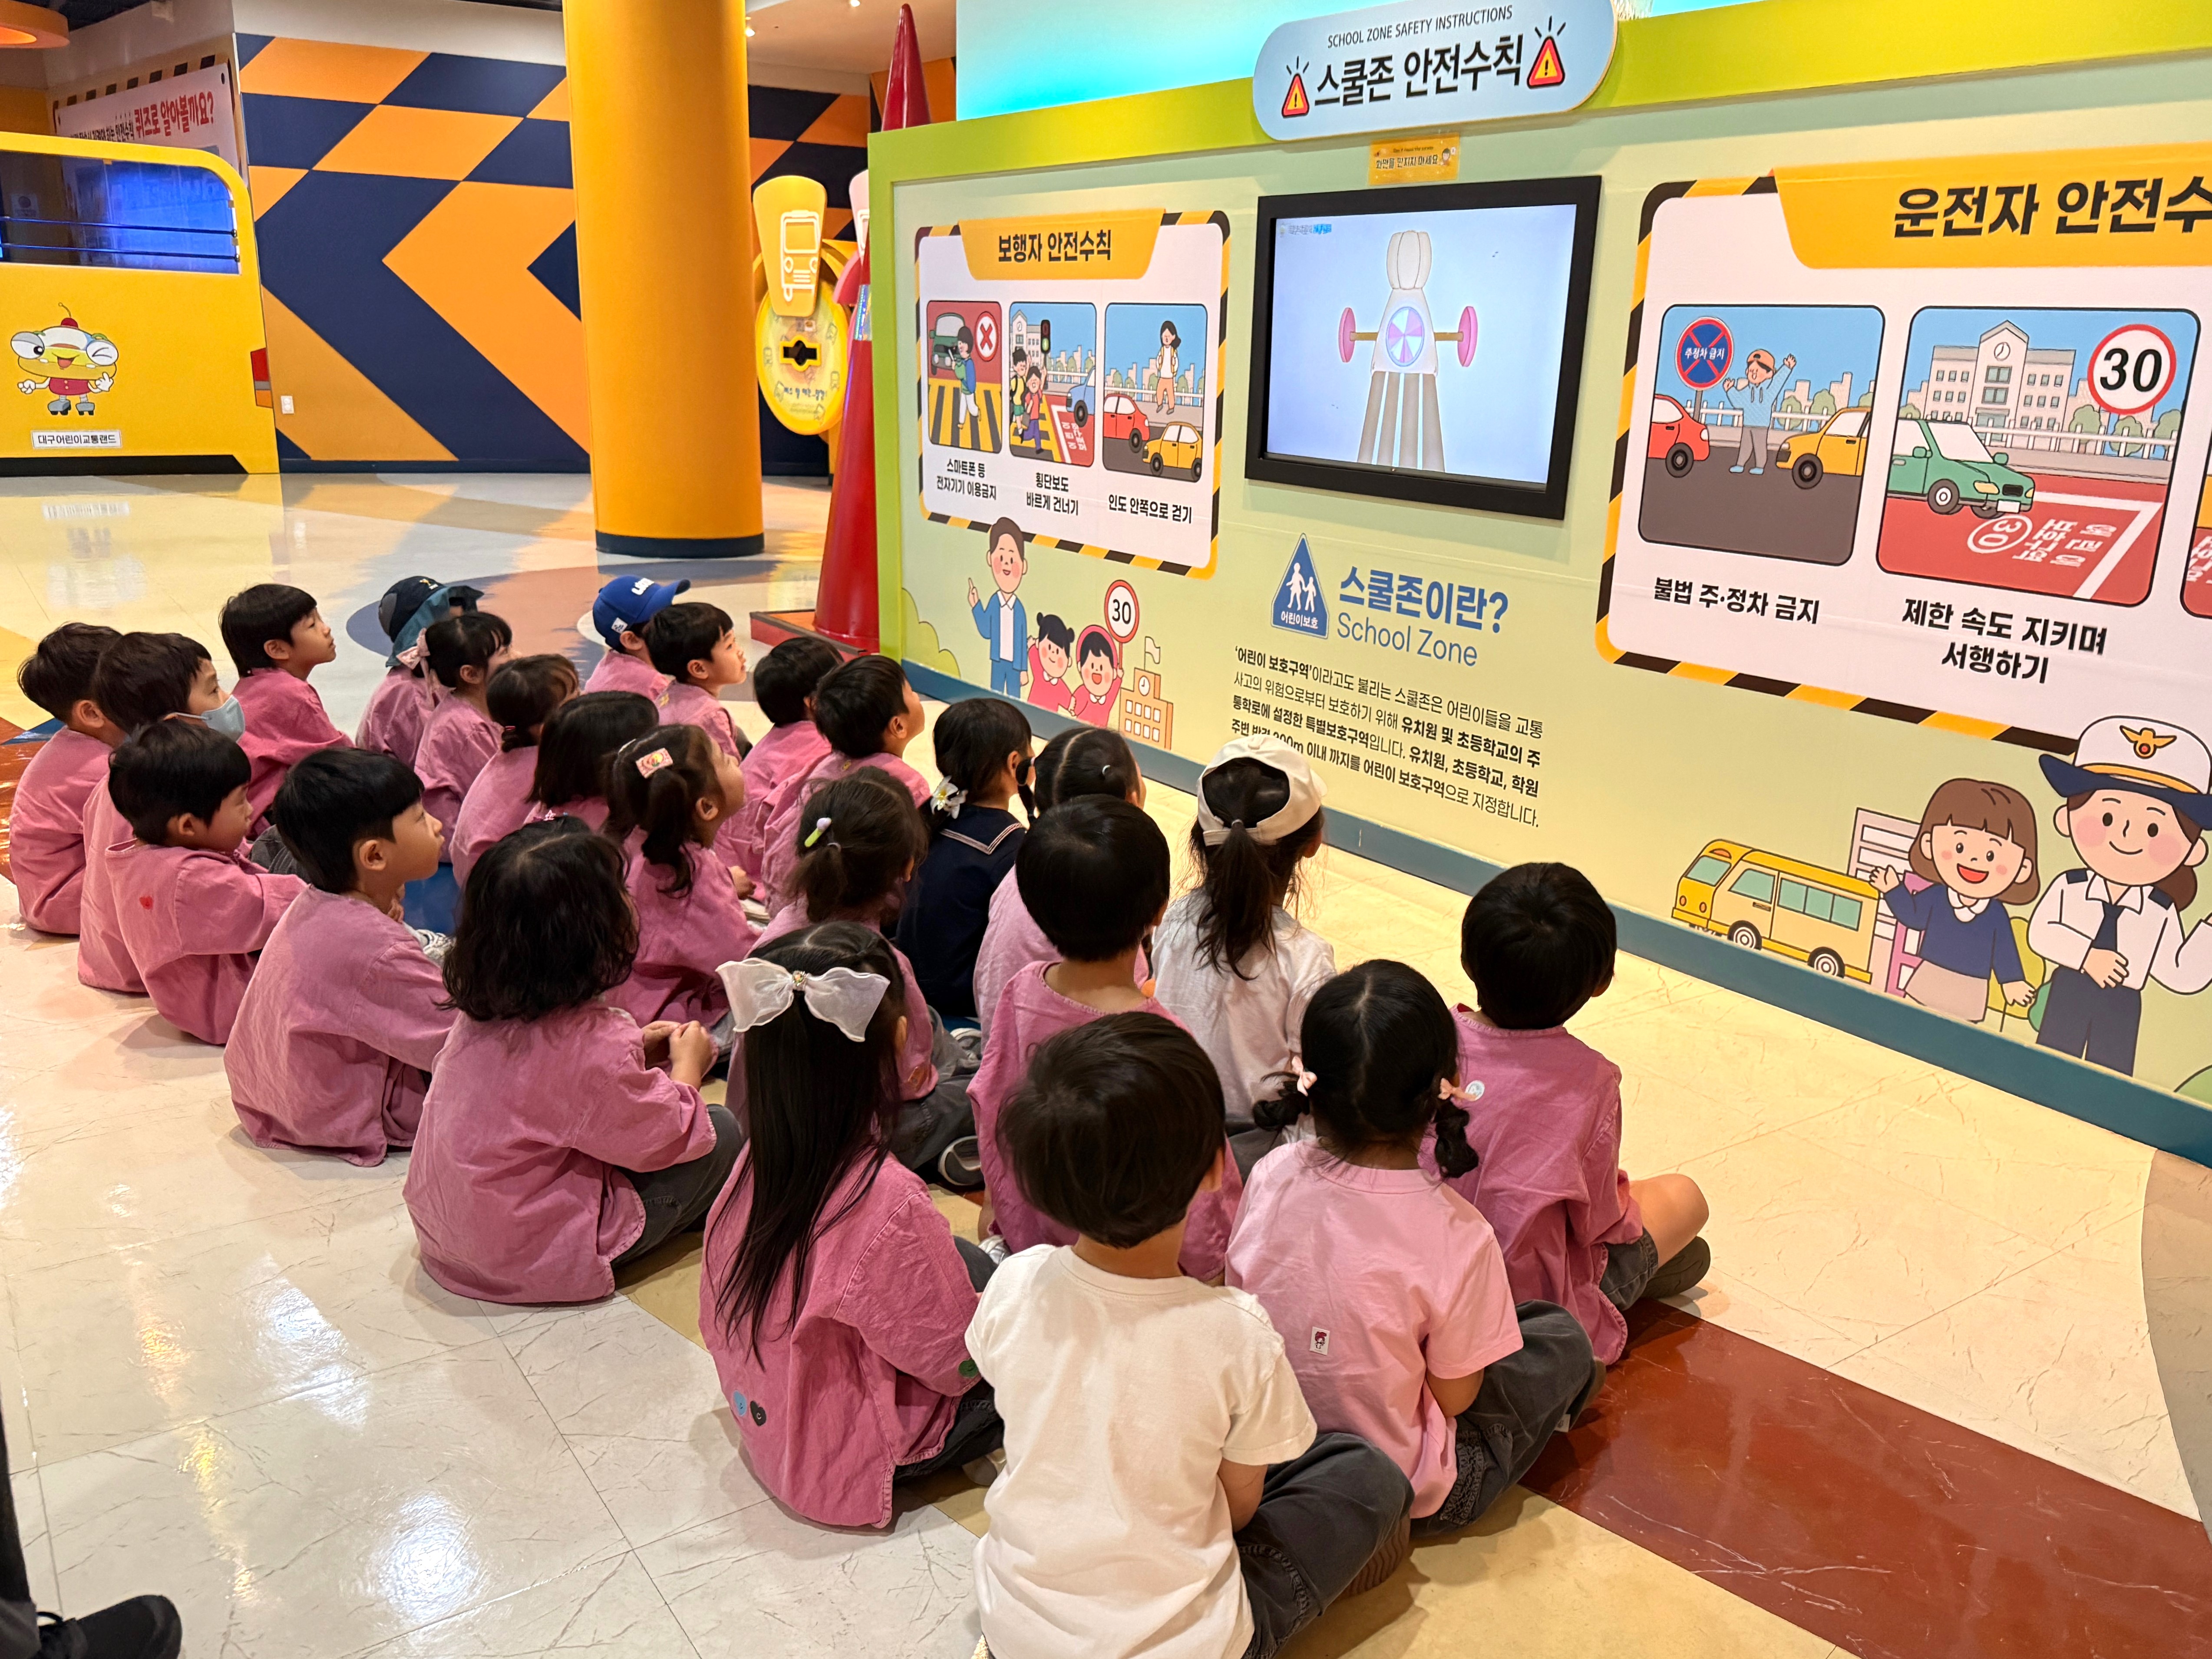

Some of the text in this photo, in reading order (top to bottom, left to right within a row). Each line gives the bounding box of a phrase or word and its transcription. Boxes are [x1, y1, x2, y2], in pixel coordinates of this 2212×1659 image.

[1328, 5, 1512, 49] SCHOOL ZONE SAFETY INSTRUCTIONS
[1314, 33, 1523, 107] 스쿨존 안전수칙
[134, 104, 161, 139] 퀴즈로
[161, 91, 214, 137] 알아볼까요?
[1376, 154, 1438, 169] 화면을 만지지 마세요
[1894, 176, 2212, 238] 운전자 안전수
[998, 229, 1112, 263] 보행자 안전수칙
[1685, 348, 1725, 360] 주정차 금지
[2100, 348, 2162, 392] 30
[38, 434, 116, 445] 대구어린이교통랜드
[937, 475, 997, 501] 전자기기 이용금지
[947, 458, 985, 478] 스마트폰 등
[1036, 472, 1069, 492] 횡단보도
[1027, 491, 1079, 516] 바르게 건너기
[1109, 494, 1192, 524] 인도 안쪽으로 걷기
[1112, 598, 1132, 624] 30
[1281, 611, 1318, 630] 어린이보호
[1339, 566, 1509, 633] 스쿨존이란?
[1653, 577, 1693, 606] 불법
[1775, 594, 1820, 625] 금지
[1337, 612, 1477, 667] School Zone
[1902, 597, 2107, 656] 제한 속도 지키며
[1941, 642, 2049, 685] 서행하기
[1234, 671, 1540, 768] 사고의 위험으로부터 보호하기 위해 유치원 및 초등학교의 주
[1358, 677, 1391, 701] 불리는
[1395, 688, 1443, 714] 스쿨존은
[1447, 700, 1511, 732] 어린이들을
[1515, 717, 1543, 739] 교통
[1233, 695, 1539, 798] 통학로에 설정한 특별보호구역입니다. 유치원, 초등학교, 학원
[1231, 719, 1250, 737] 주변
[1307, 742, 1327, 761] 이내
[1329, 748, 1360, 772] 까지를
[1364, 759, 1396, 783] 어린이
[1399, 769, 1469, 805] 보호구역으로
[1472, 792, 1539, 828] 지정합니다.
